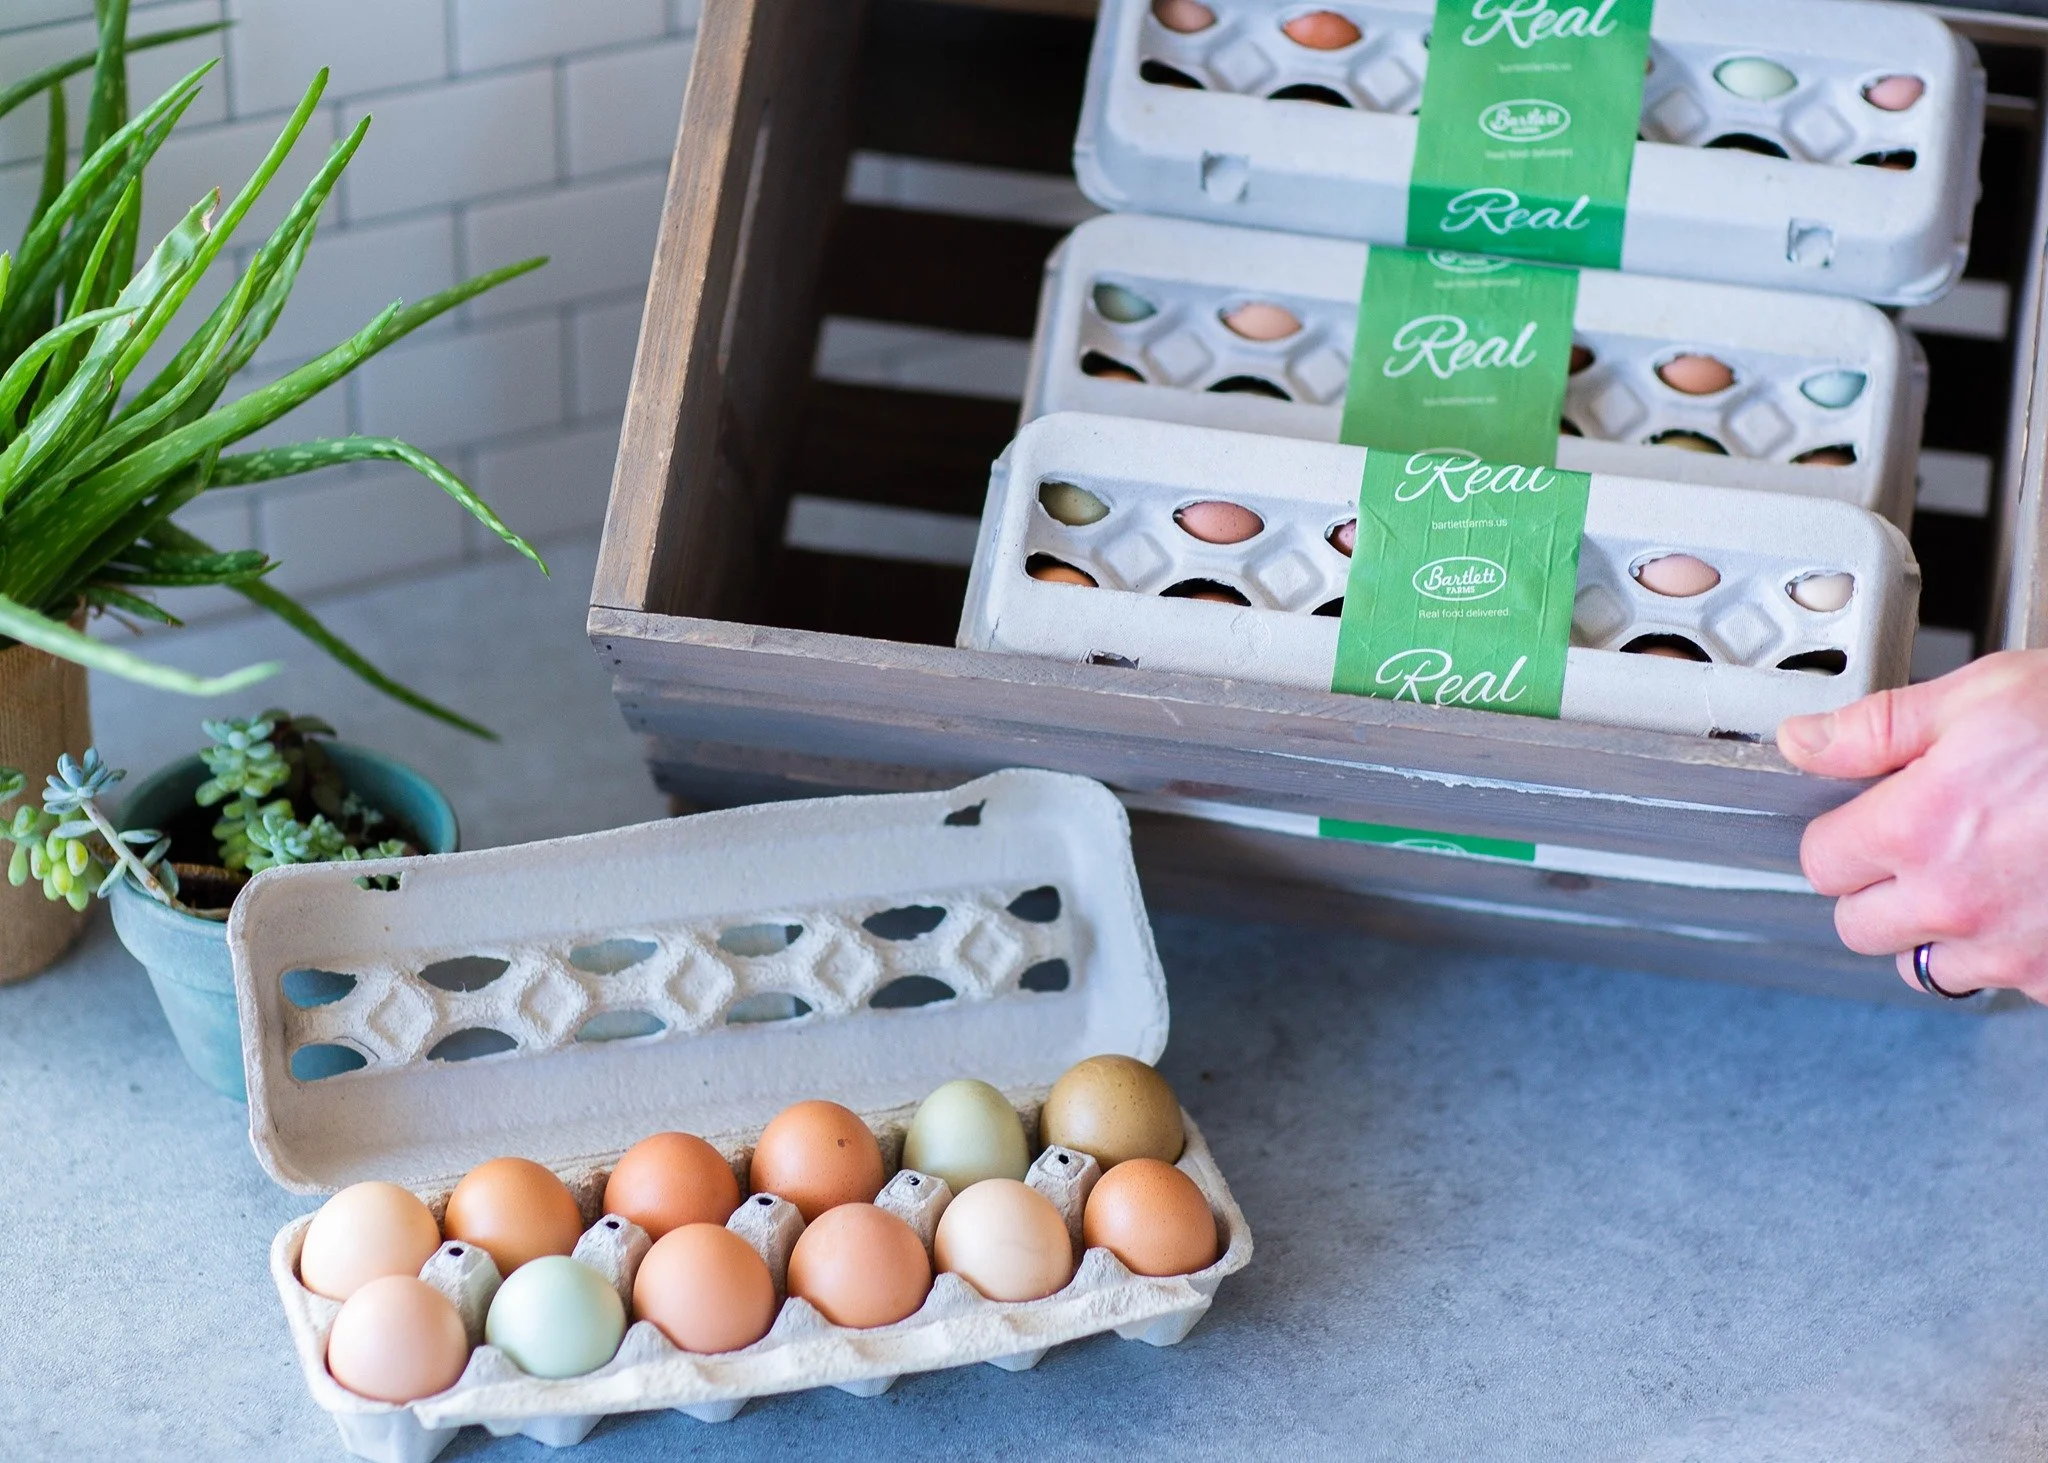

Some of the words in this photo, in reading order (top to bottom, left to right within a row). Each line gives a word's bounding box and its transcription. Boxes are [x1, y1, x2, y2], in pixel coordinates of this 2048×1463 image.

[1461, 0, 1619, 49] Real
[1440, 187, 1591, 235] Real
[1382, 314, 1538, 379] Real
[1431, 518, 1508, 530] bartlettfarms.us
[1423, 565, 1497, 591] Bartlett
[1446, 585, 1476, 595] FARMS
[1418, 609, 1440, 619] Real
[1442, 608, 1464, 618] food
[1370, 648, 1528, 709] Real
